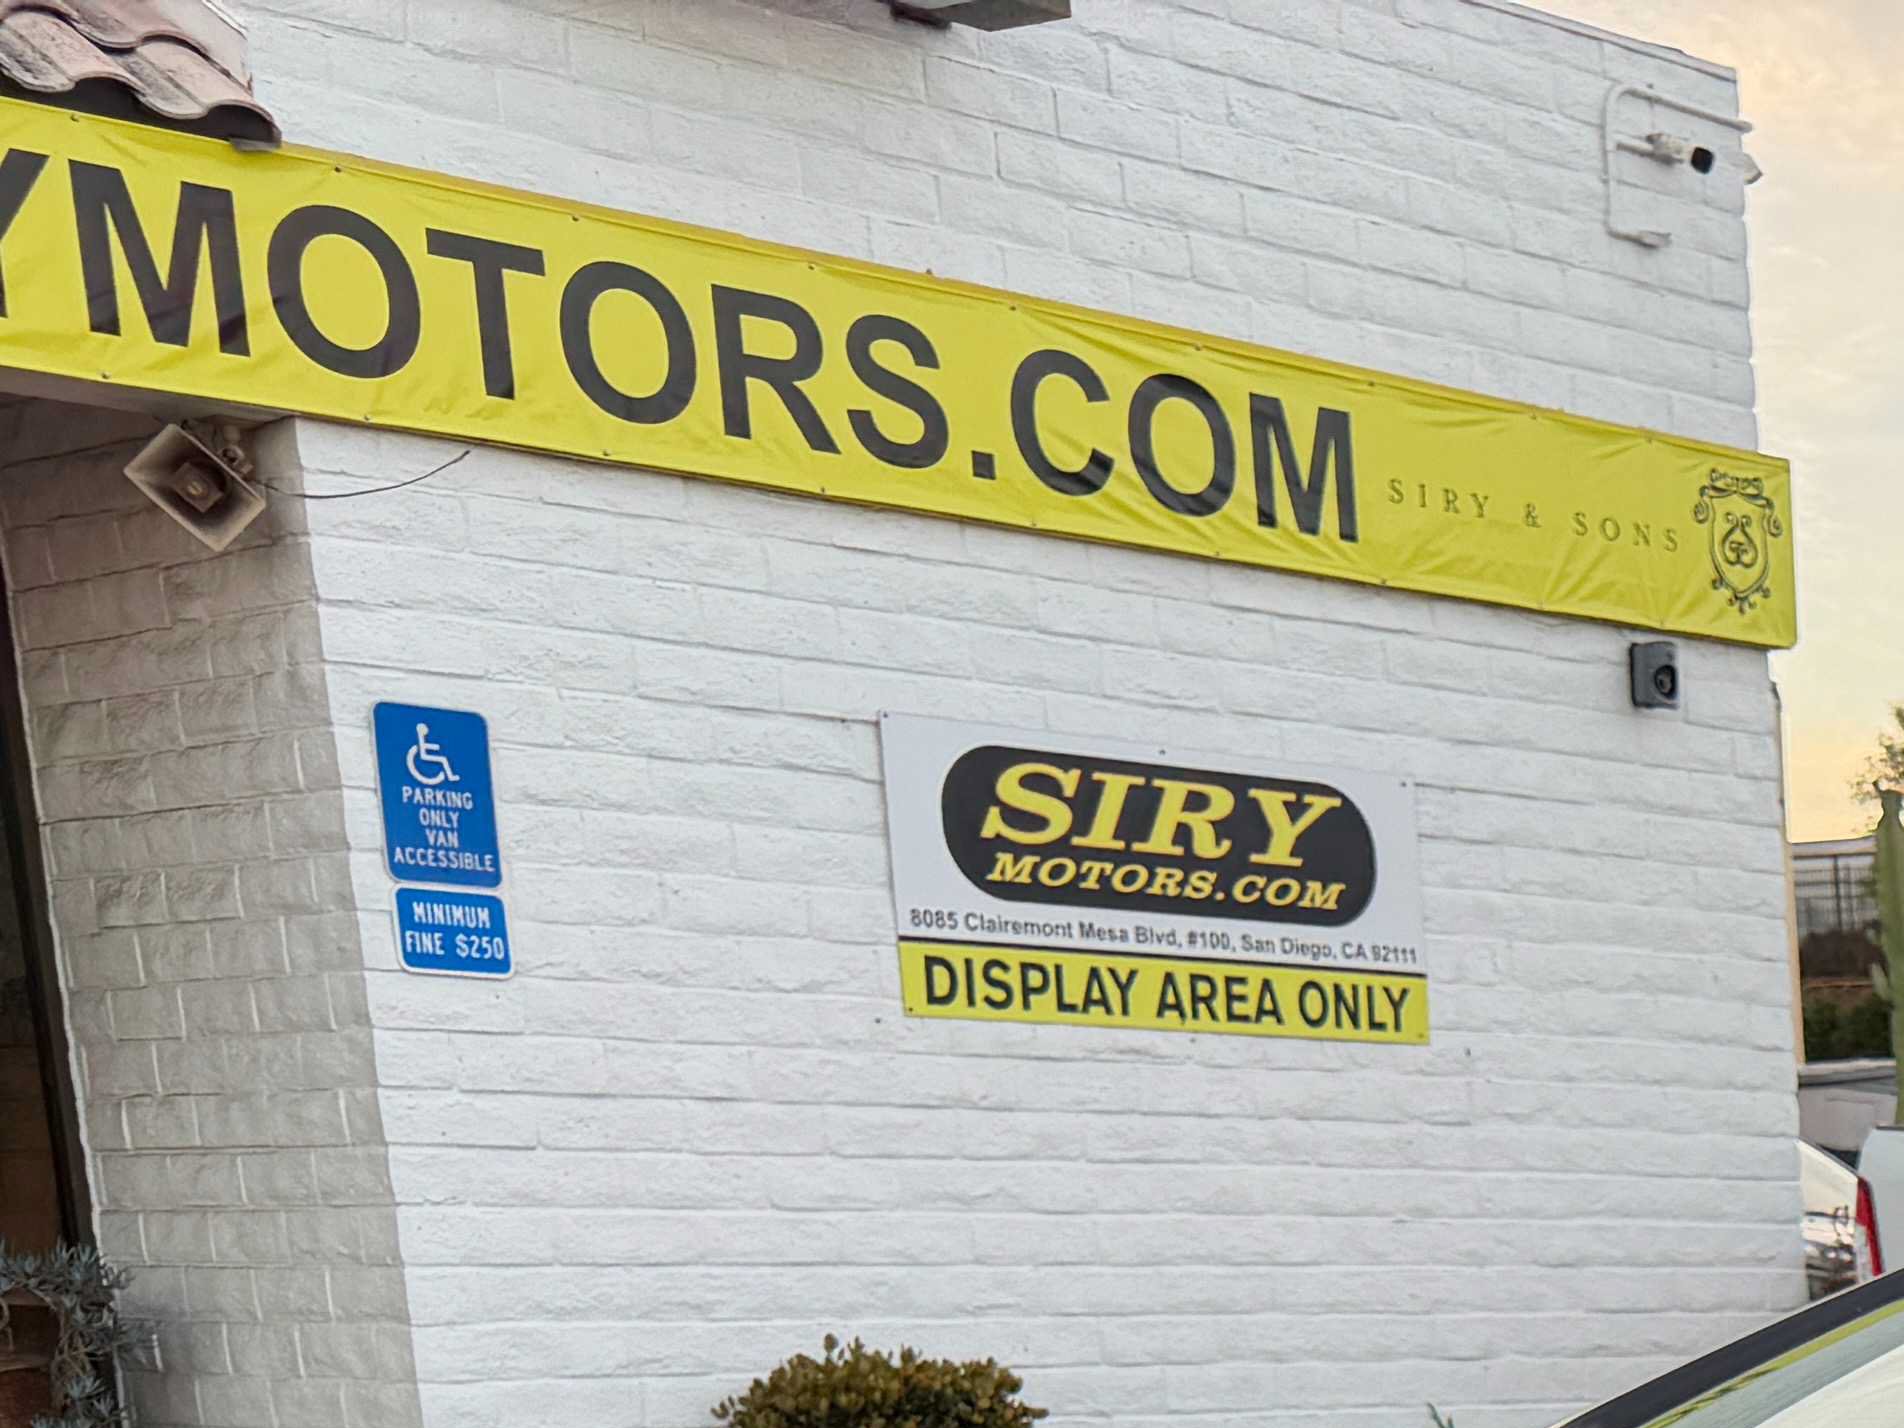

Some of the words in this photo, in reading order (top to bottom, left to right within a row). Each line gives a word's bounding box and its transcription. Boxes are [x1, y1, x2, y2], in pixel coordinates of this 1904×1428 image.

[1387, 478, 1490, 520] SIRY
[1524, 502, 1542, 529] &
[1573, 511, 1680, 554] SONS
[402, 786, 474, 810] PARKING
[418, 809, 460, 828] ONLY
[980, 762, 1342, 868] SIRY
[426, 829, 460, 849] VAN
[393, 847, 496, 873] ACCESSIBLE
[985, 852, 1346, 911] MOTORS.COM
[412, 901, 491, 929] MINIMUM
[404, 930, 445, 956] FINE
[455, 934, 505, 961] $250
[910, 908, 959, 932] 8085
[964, 912, 1074, 941] Clairemont
[1079, 919, 1131, 944] Mesa
[1241, 934, 1277, 957] San
[1342, 942, 1369, 962] CA
[922, 955, 1140, 1019] DISPLAY
[1156, 973, 1286, 1026] AREA
[1299, 980, 1410, 1034] ONLY
